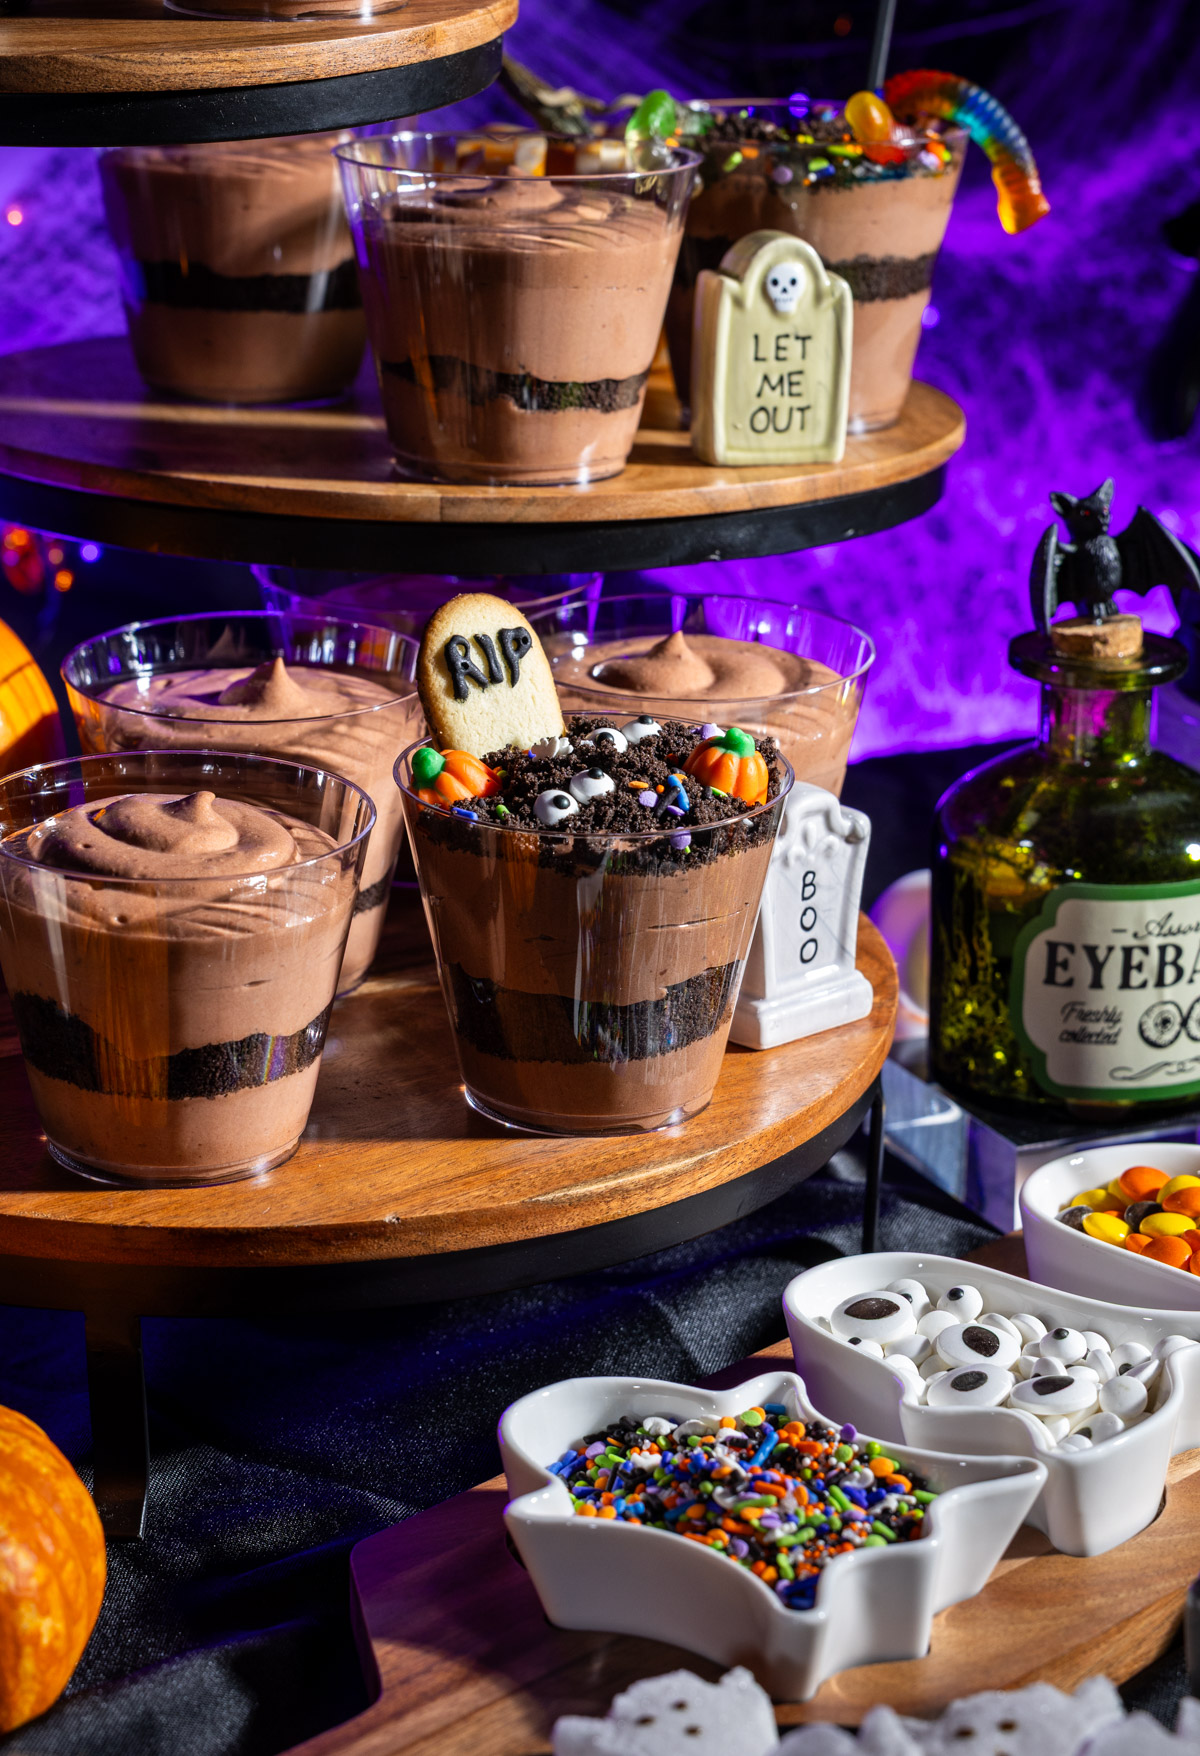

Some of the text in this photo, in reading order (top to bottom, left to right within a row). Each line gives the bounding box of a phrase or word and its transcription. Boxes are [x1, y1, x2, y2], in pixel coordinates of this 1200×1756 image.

[753, 333, 812, 361] LET
[756, 371, 804, 398] ME
[750, 405, 811, 434] OUT
[444, 626, 533, 703] RIP
[800, 870, 818, 964] BOO
